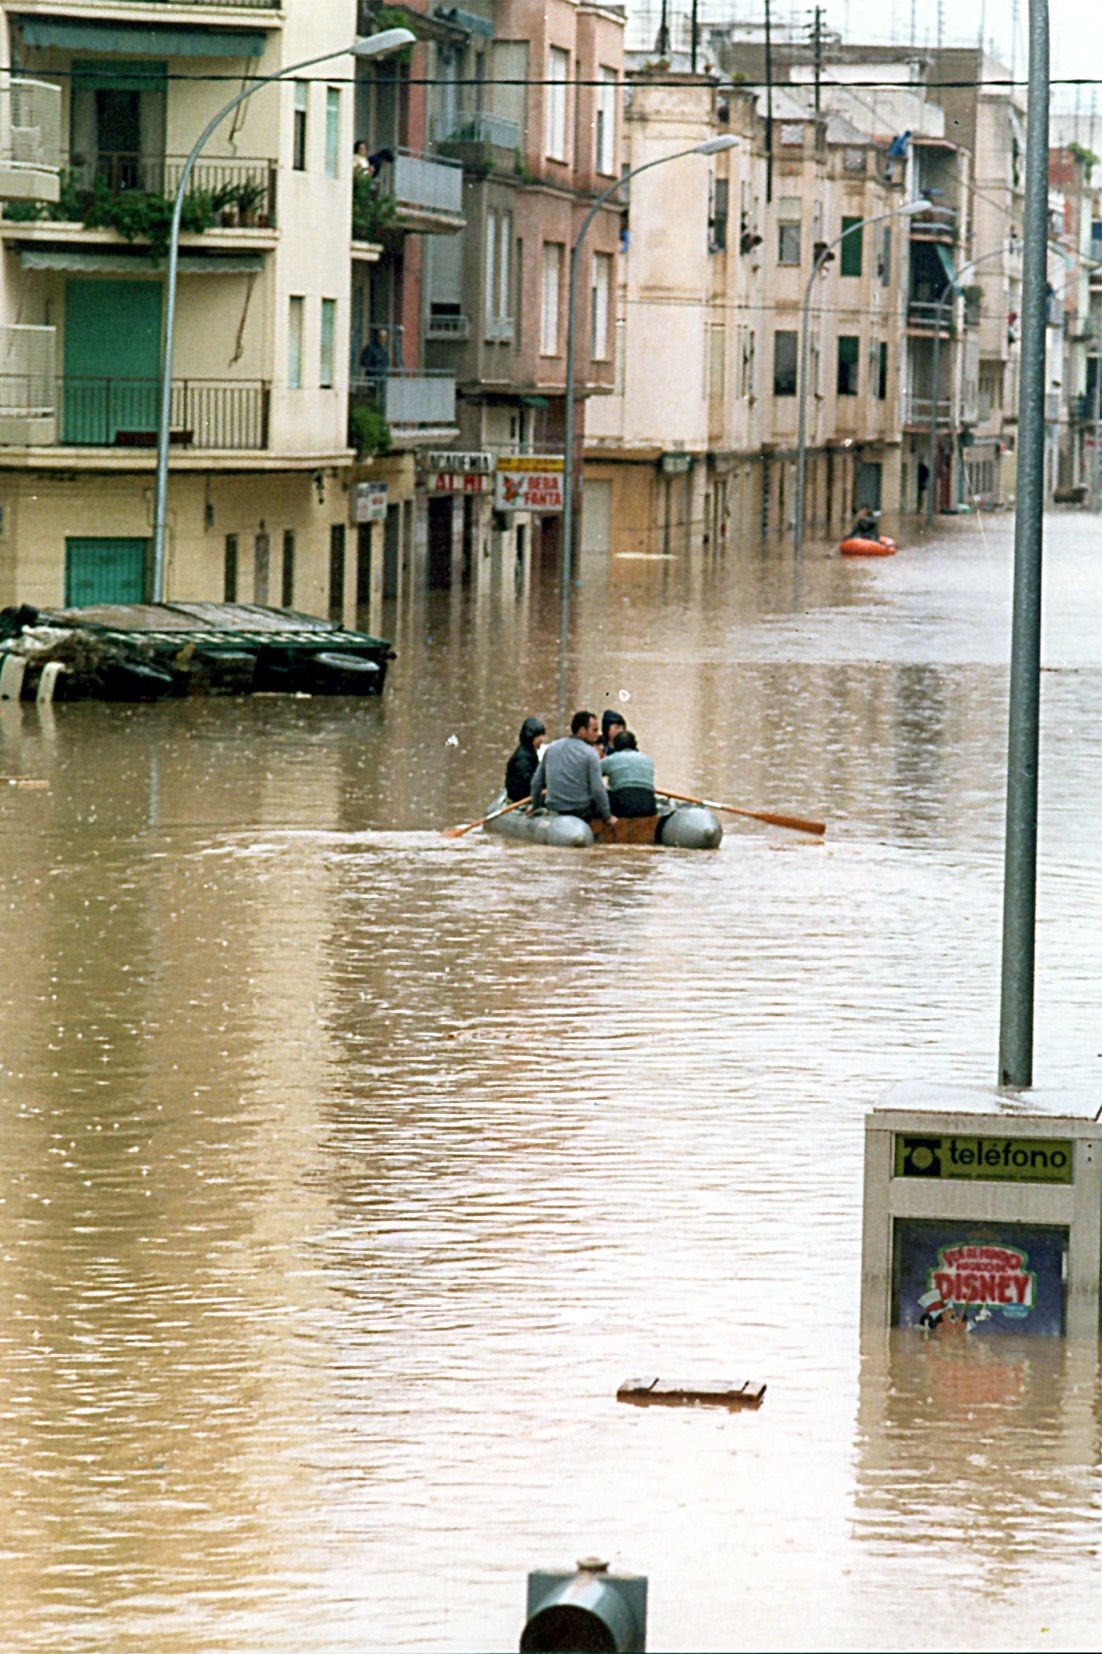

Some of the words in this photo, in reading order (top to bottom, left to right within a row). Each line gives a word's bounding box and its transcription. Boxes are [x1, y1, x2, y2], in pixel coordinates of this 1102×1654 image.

[527, 476, 559, 490] BEBA
[523, 490, 562, 505] FANTA
[948, 1140, 1067, 1169] teléfono
[932, 1271, 1030, 1304] DISNEY
